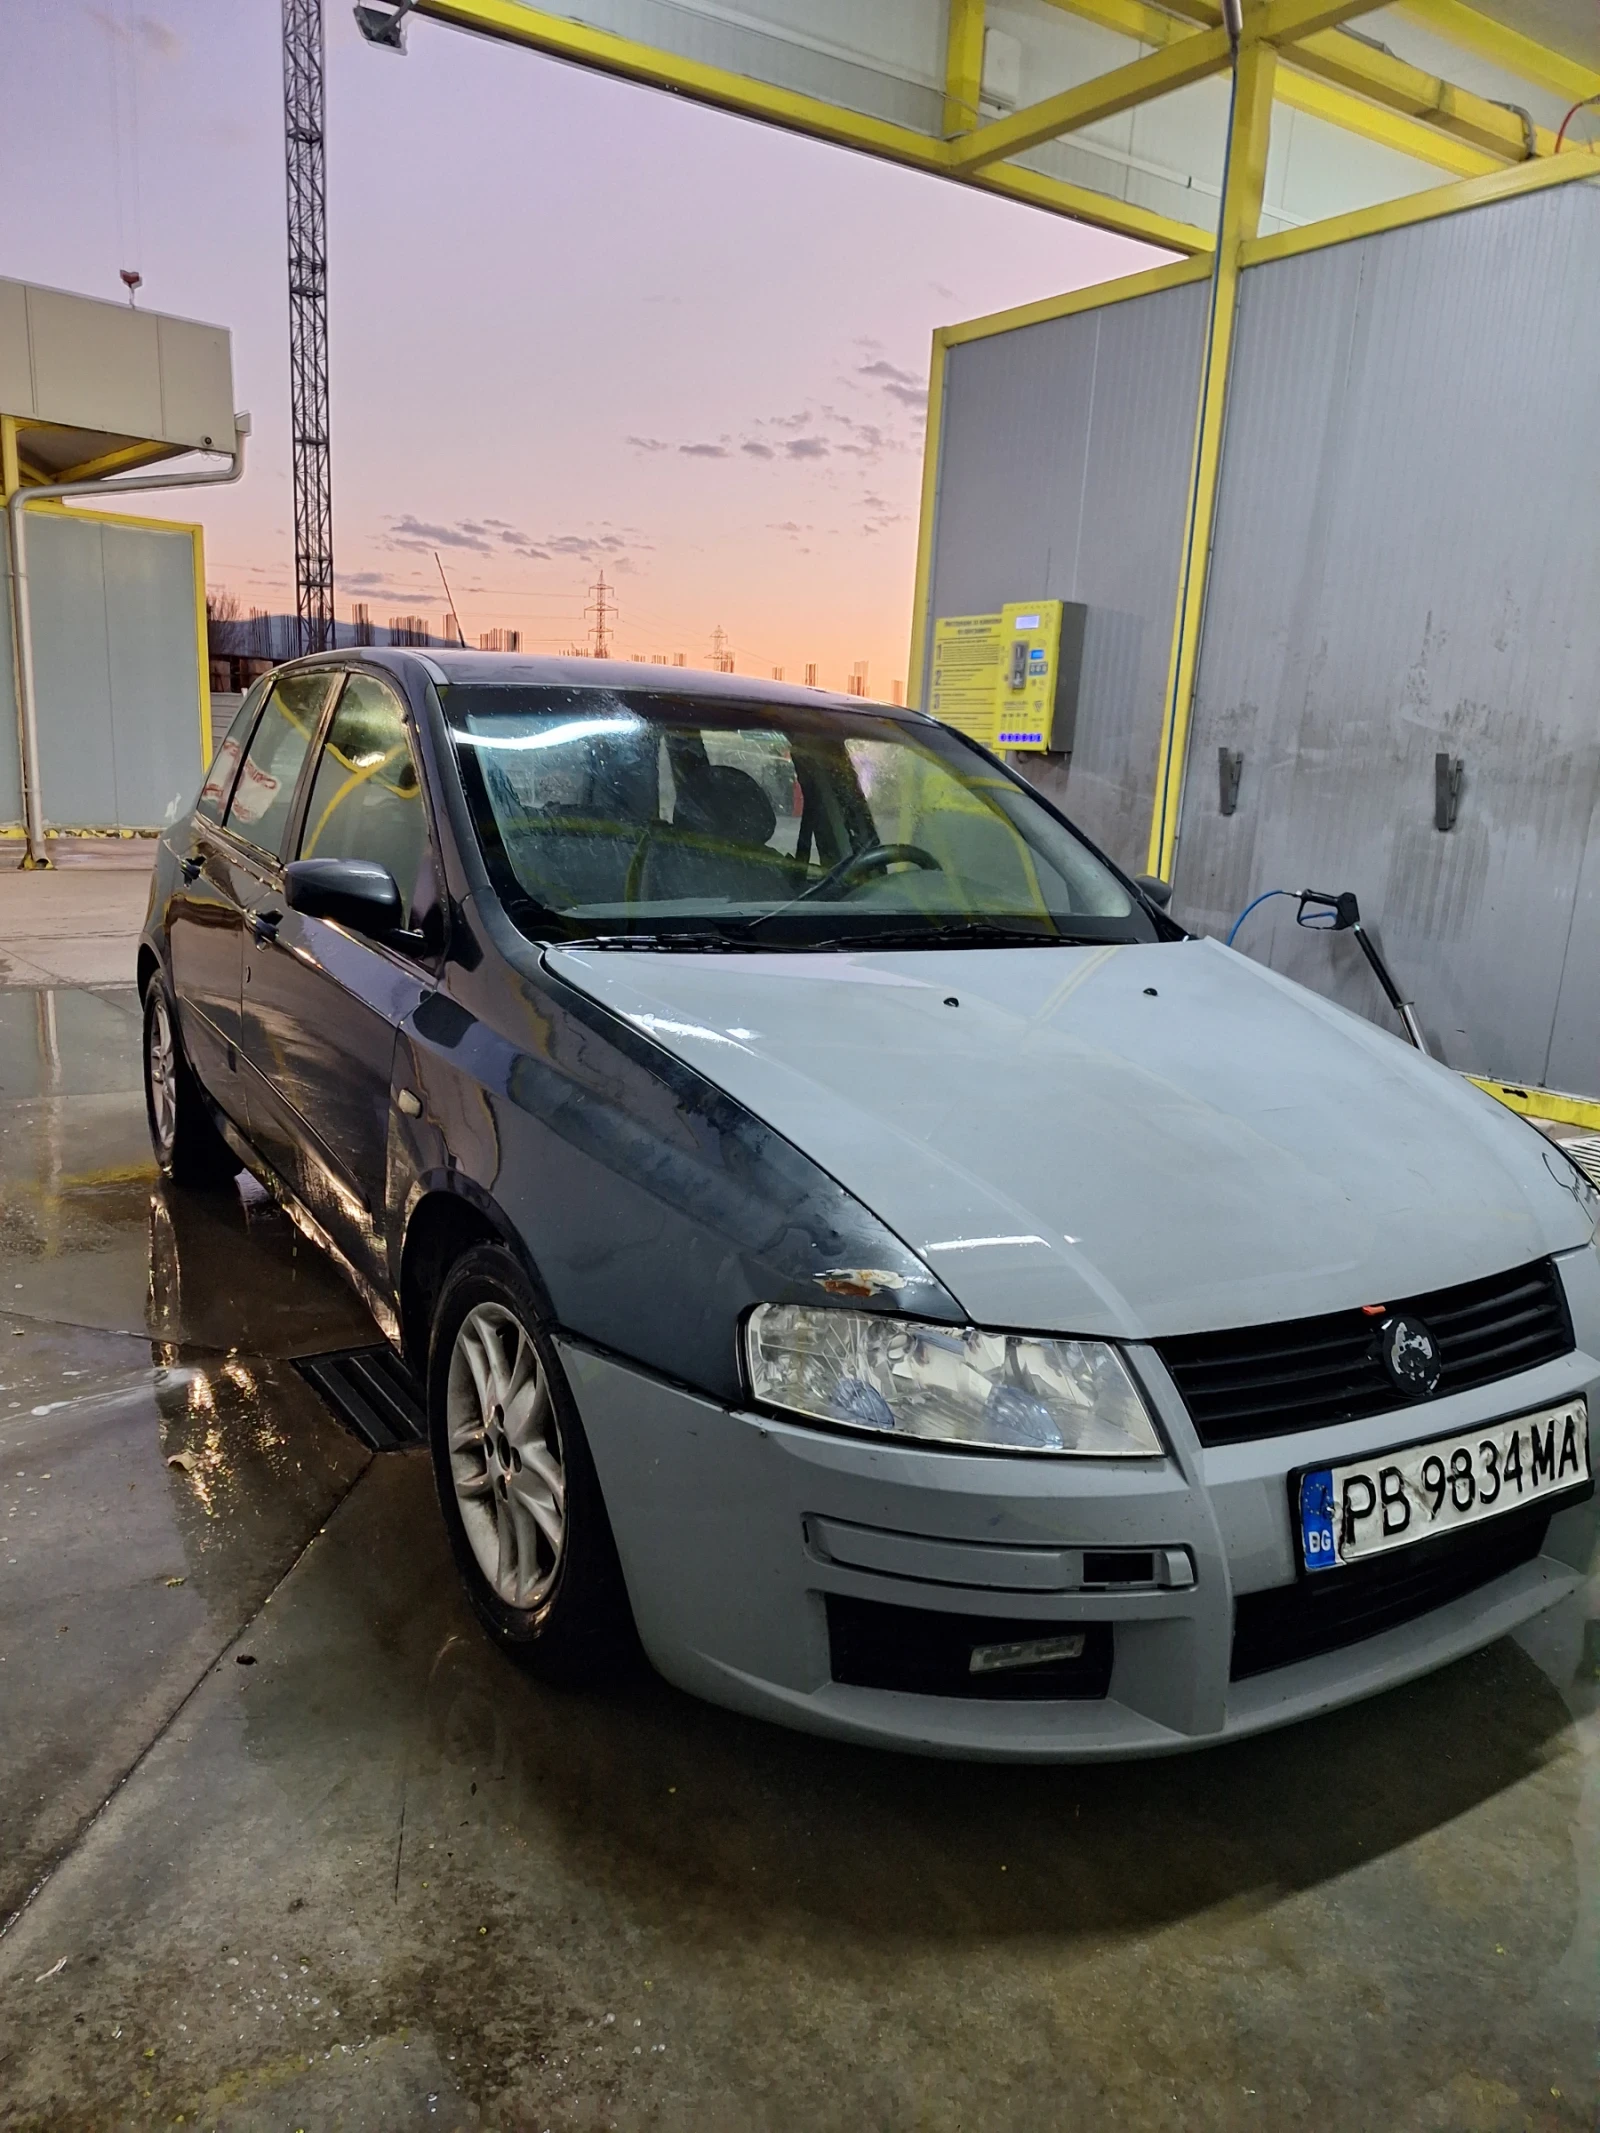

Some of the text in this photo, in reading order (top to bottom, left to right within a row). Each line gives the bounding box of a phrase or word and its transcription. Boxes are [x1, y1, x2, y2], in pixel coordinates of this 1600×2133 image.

[936, 644, 942, 660] 1
[935, 669, 942, 686] 2
[933, 692, 941, 710] 3
[1341, 1415, 1579, 1545] PB 9834 MA
[1308, 1529, 1332, 1553] BG
